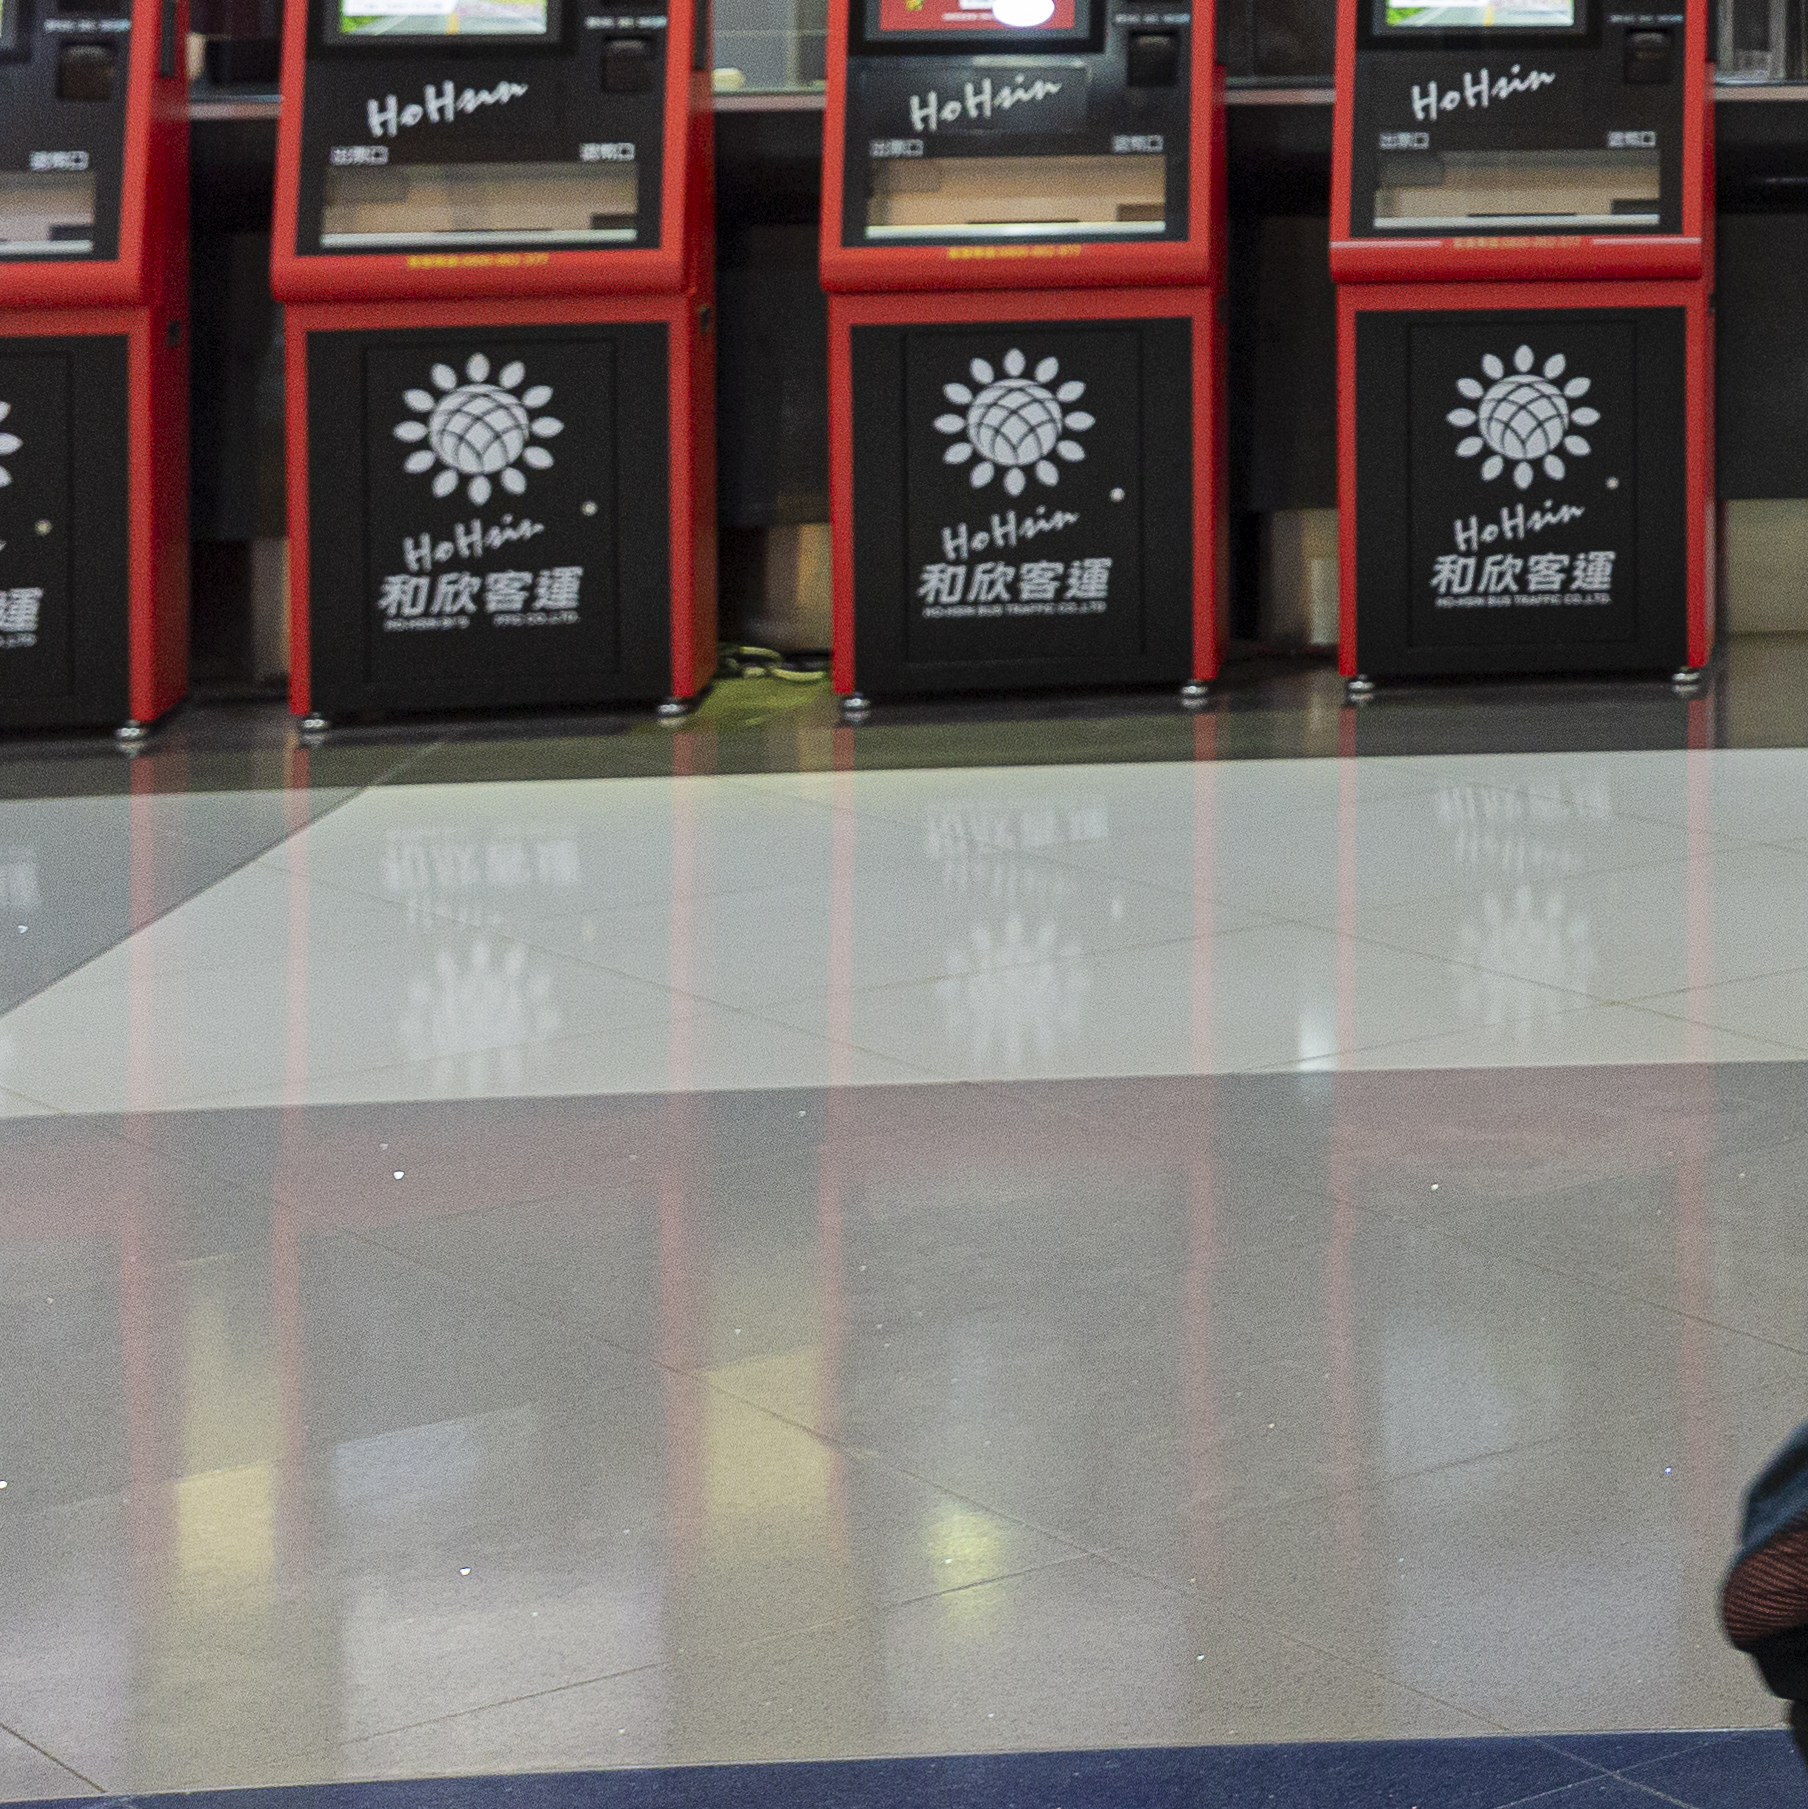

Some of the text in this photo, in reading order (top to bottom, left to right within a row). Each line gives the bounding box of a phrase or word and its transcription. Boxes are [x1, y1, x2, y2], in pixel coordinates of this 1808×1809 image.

[367, 80, 528, 138] HoHsin
[909, 74, 1062, 132] HoHsin
[1411, 64, 1556, 121] HoHsin
[403, 514, 544, 573] HoHsin
[941, 504, 1080, 561] HoHsin
[1453, 498, 1586, 552] HoHsin
[379, 566, 584, 617] 和欣客運
[917, 557, 1113, 605] 和欣客運
[1429, 550, 1617, 594] 和欣客運
